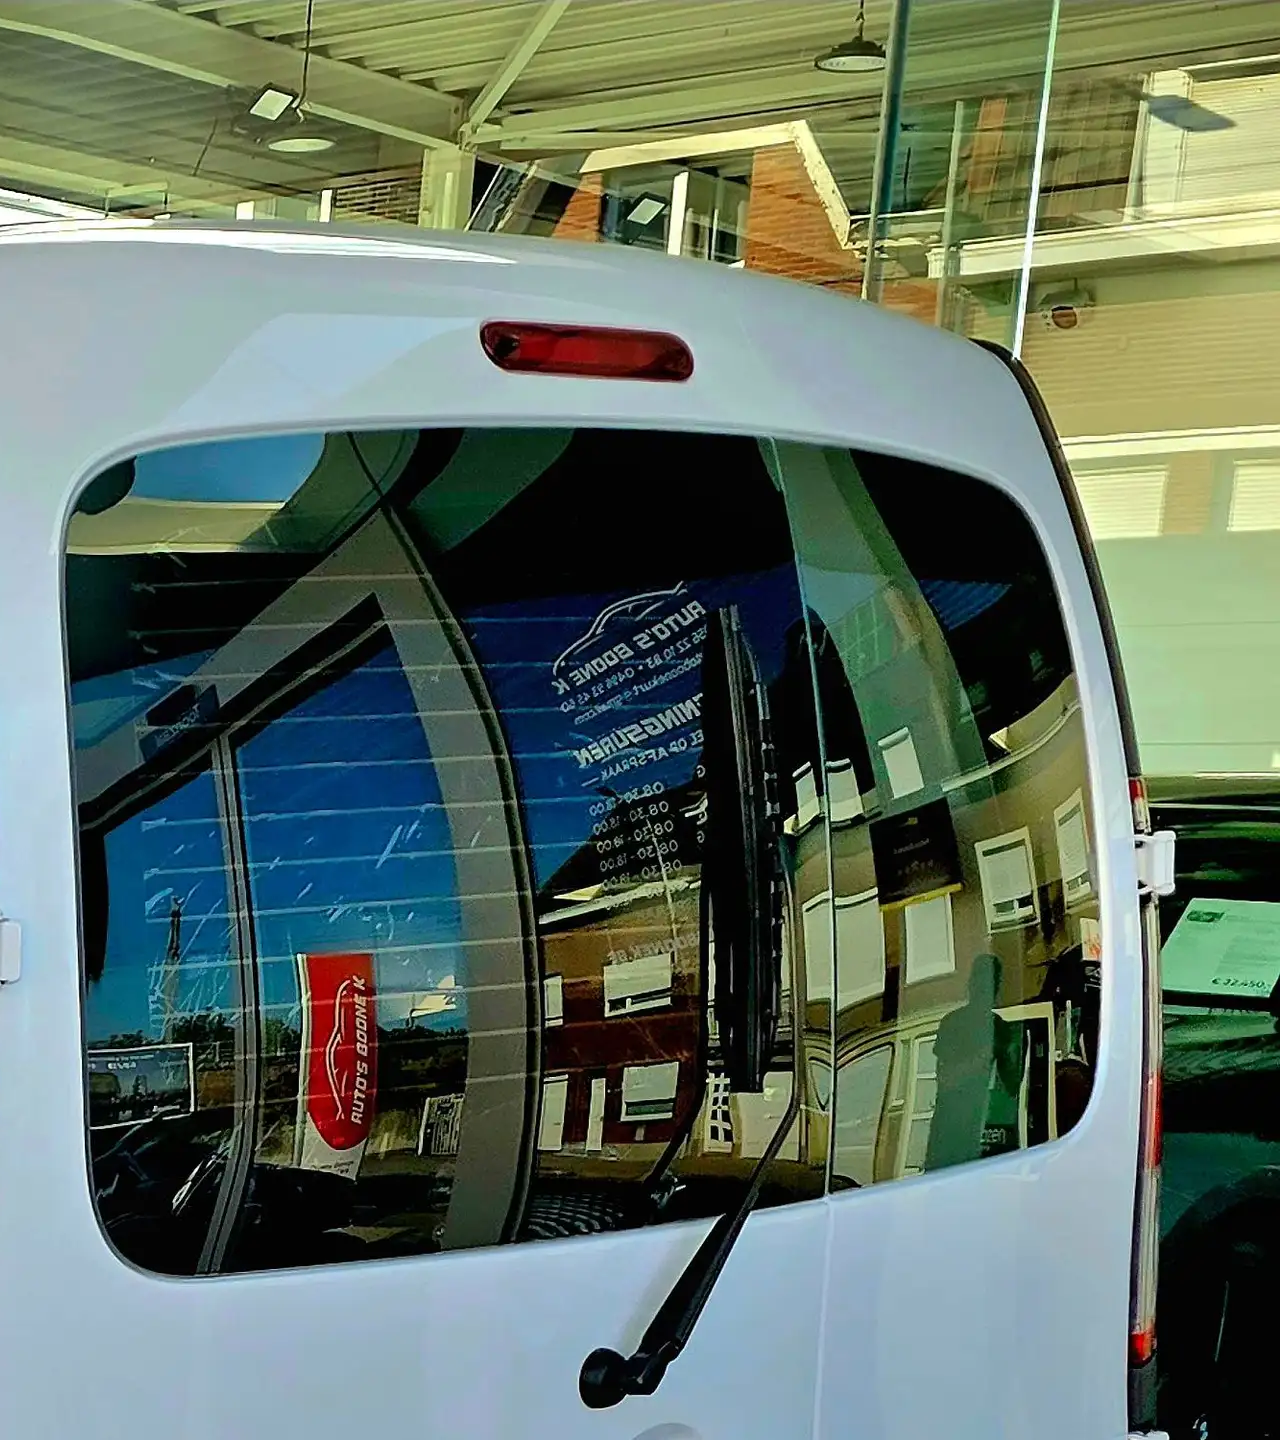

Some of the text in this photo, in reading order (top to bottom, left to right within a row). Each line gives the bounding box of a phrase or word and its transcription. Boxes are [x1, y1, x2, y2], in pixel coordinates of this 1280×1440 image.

[351, 974, 368, 1125] AUTO'S BOONE K
